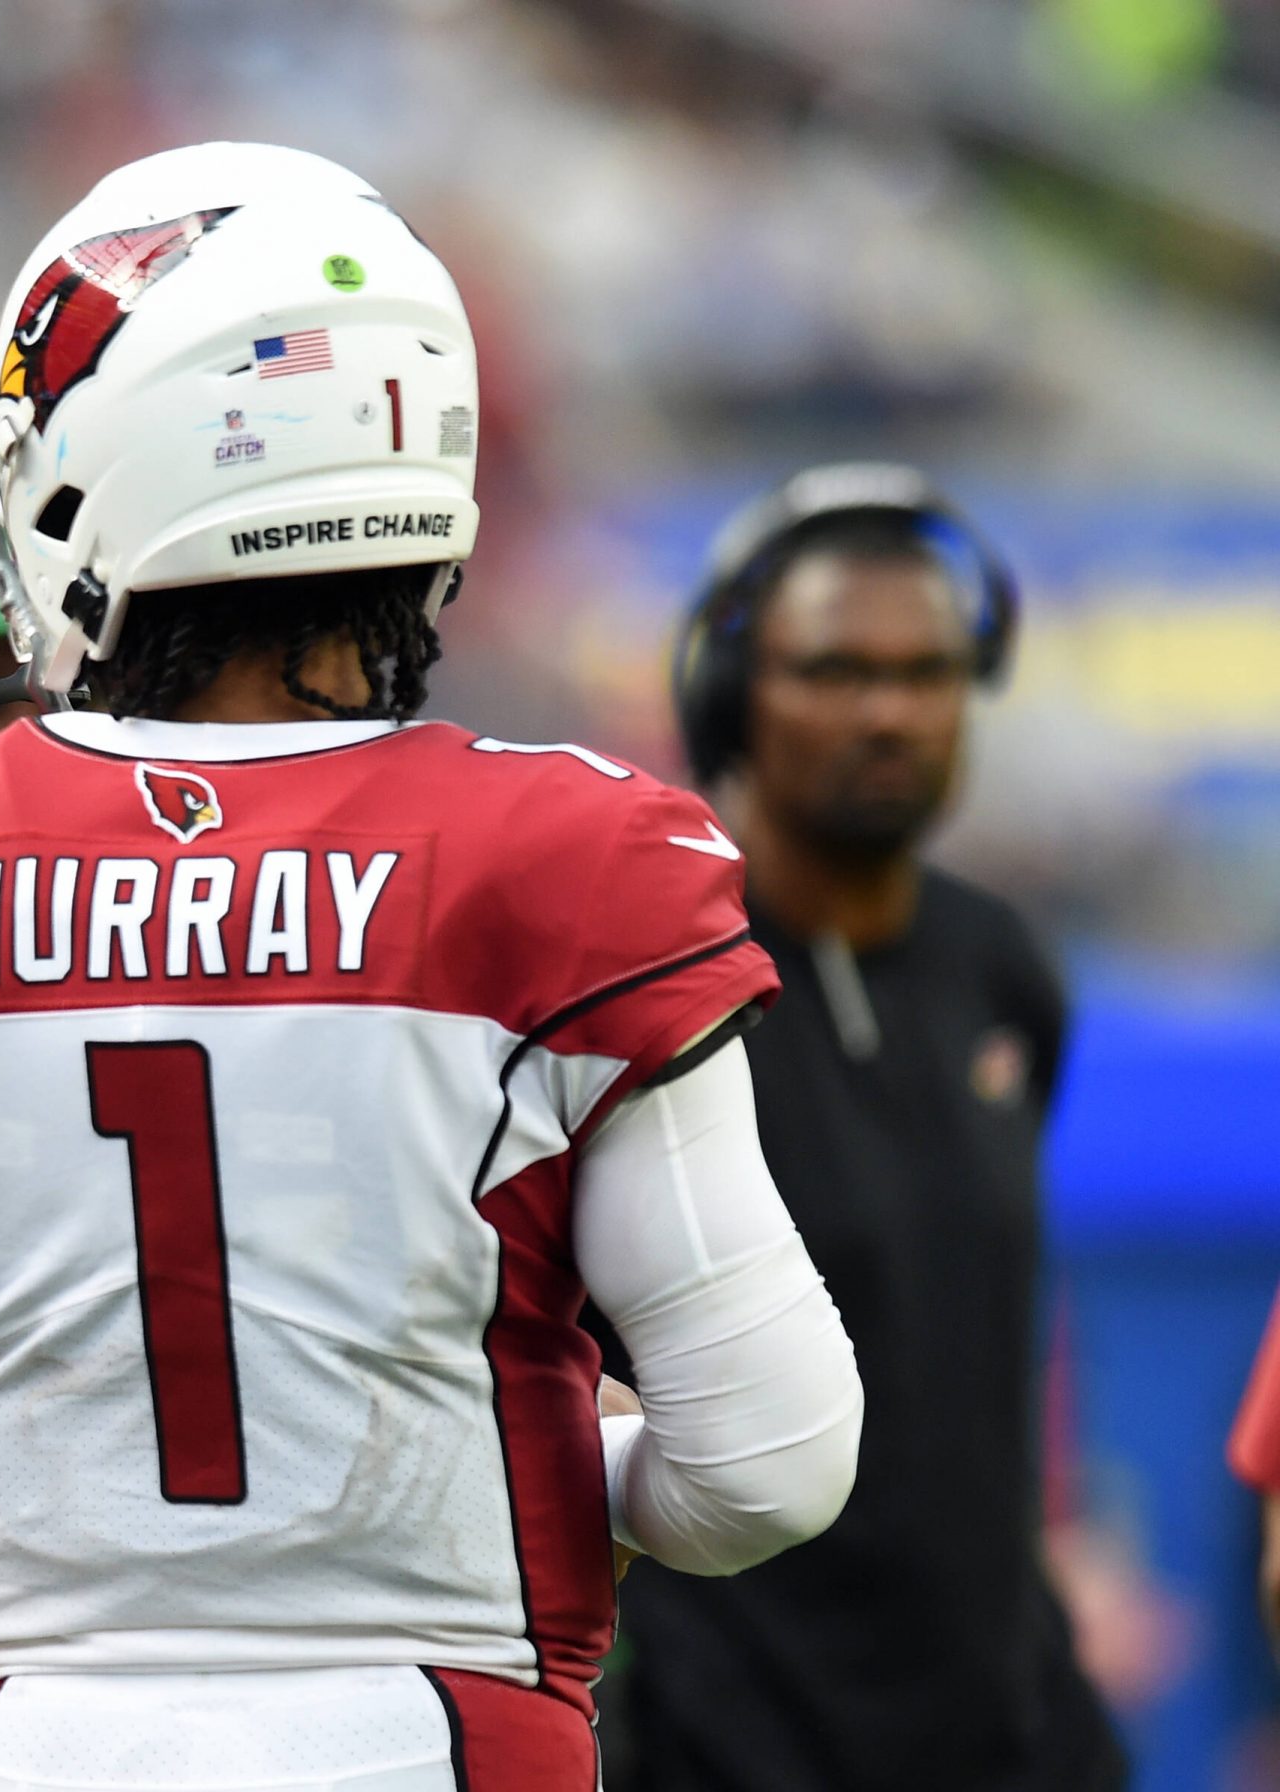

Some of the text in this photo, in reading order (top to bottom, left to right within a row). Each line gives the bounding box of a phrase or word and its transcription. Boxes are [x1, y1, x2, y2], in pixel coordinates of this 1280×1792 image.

[384, 378, 404, 453] 1
[231, 513, 454, 557] INSPIRE CHANGE
[84, 1039, 248, 1505] 1
